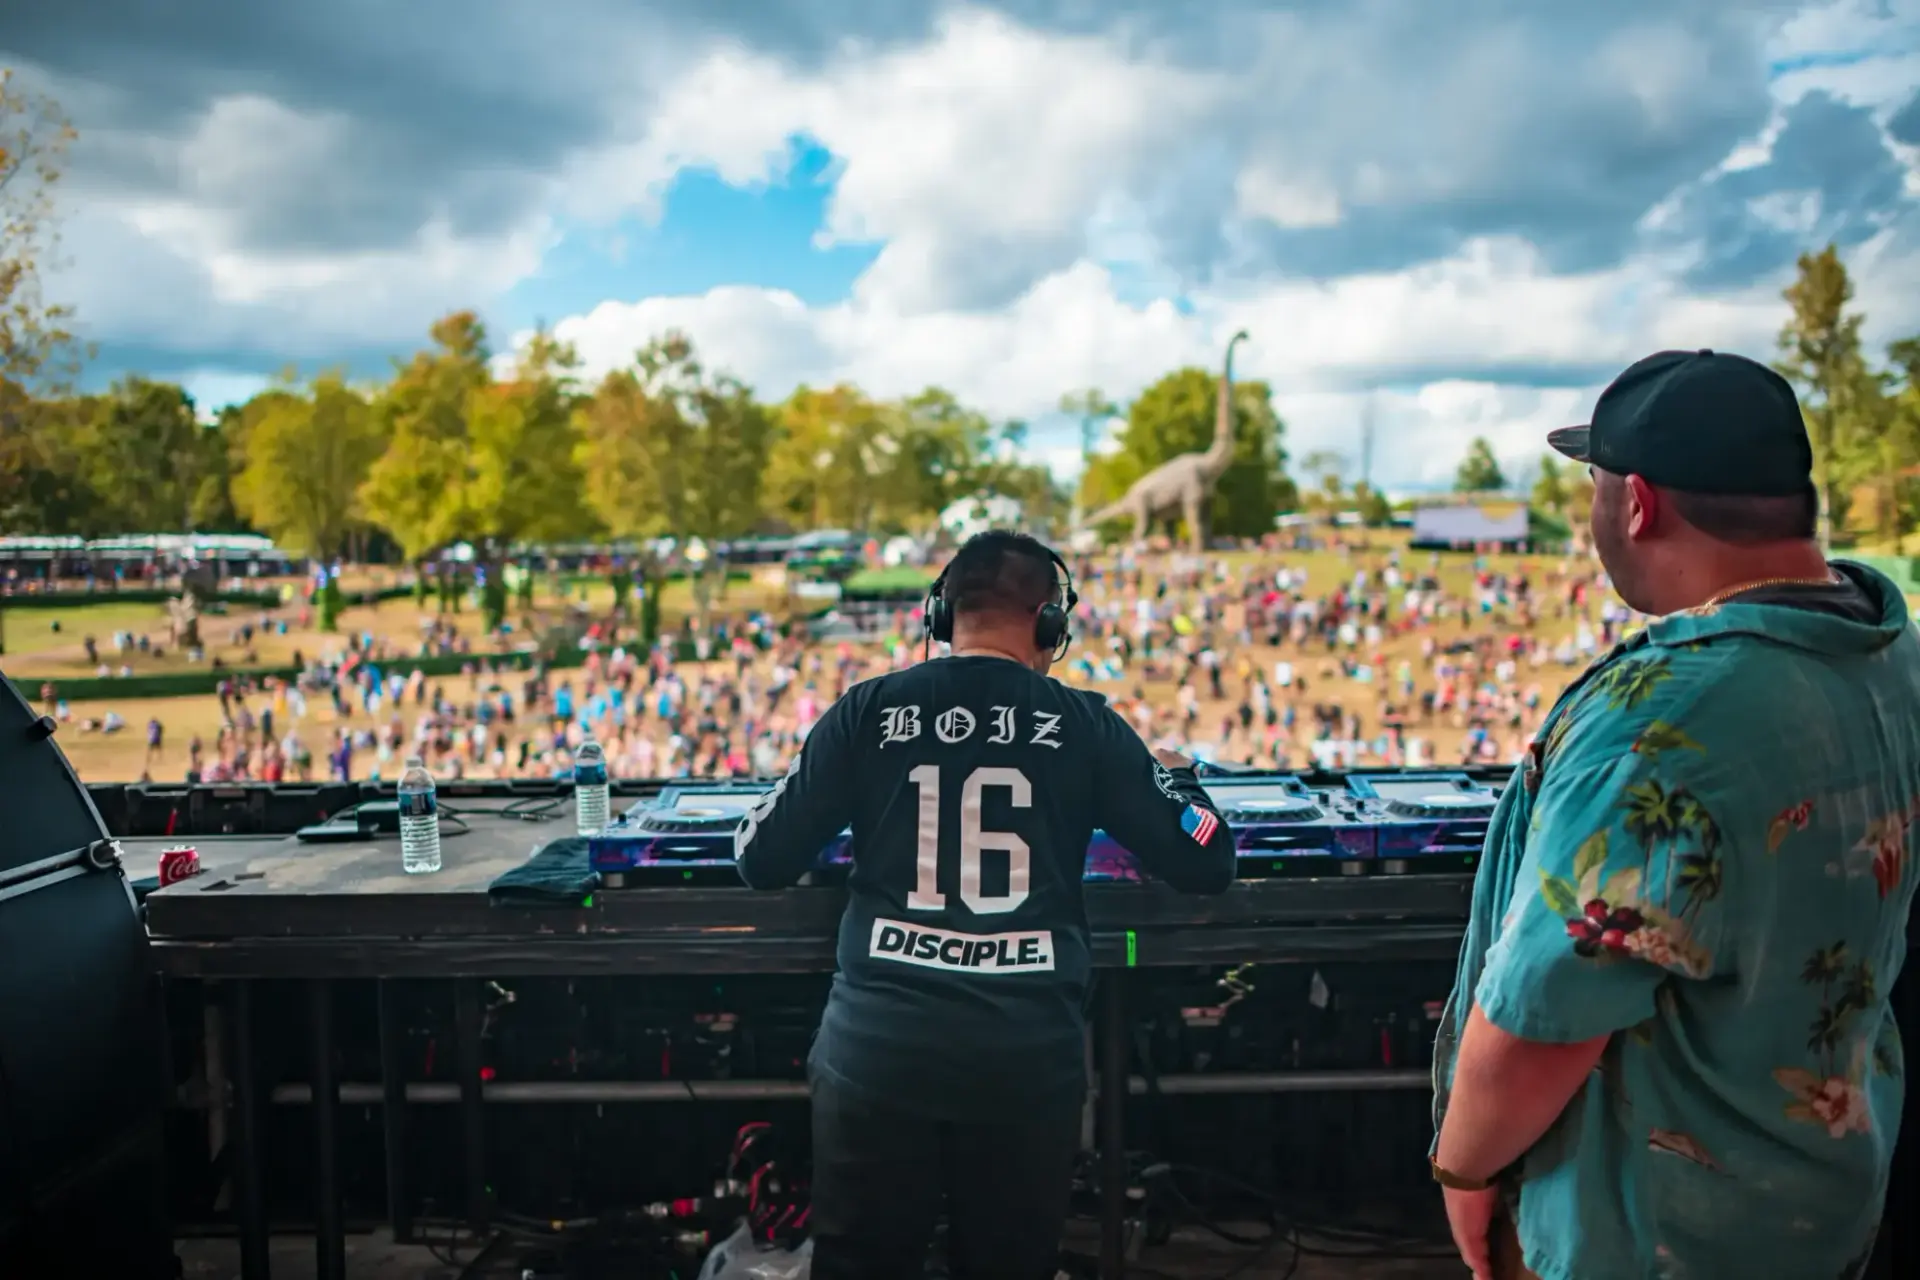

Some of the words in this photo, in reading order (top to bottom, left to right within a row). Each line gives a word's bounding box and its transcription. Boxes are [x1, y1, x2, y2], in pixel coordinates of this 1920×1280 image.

[879, 704, 1063, 749] BOIZ
[906, 764, 1032, 914] 16
[877, 926, 1048, 967] DISCIPLE.
